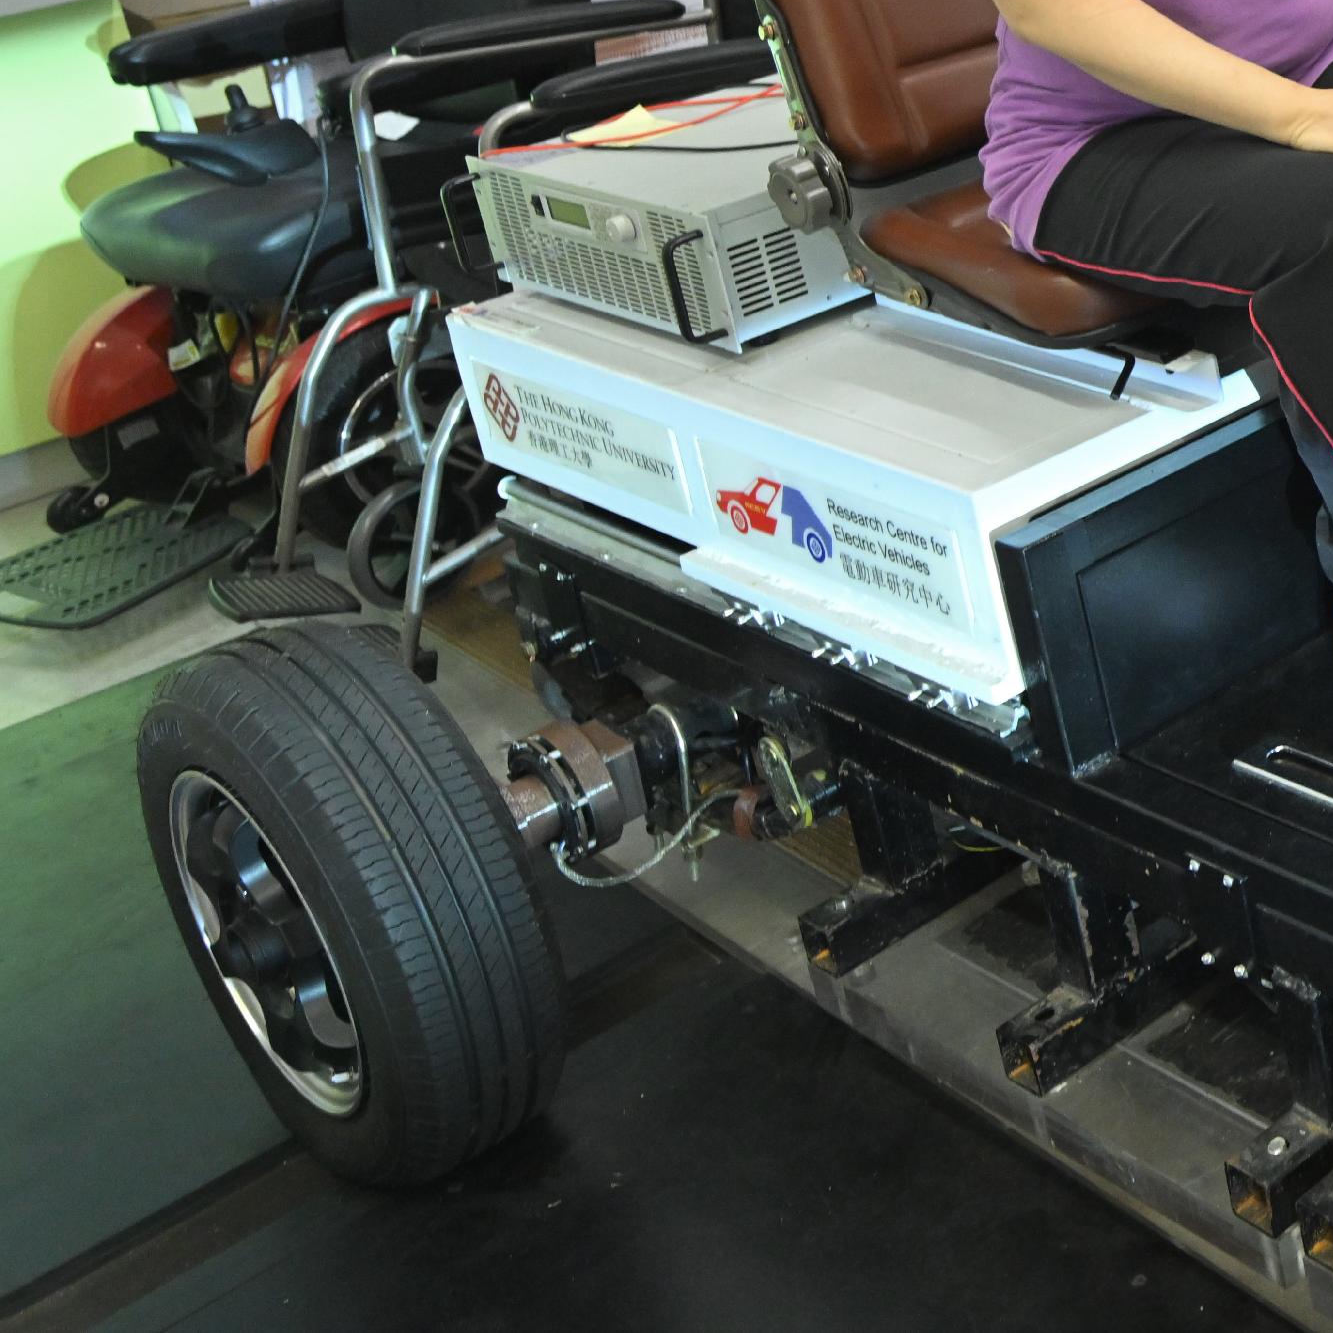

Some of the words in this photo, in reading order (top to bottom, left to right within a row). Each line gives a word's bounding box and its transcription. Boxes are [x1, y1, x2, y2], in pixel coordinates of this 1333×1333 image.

[514, 385, 538, 409] THE
[540, 393, 574, 422] HONG
[575, 407, 615, 438] KONG
[520, 407, 599, 451] POLYTECHNIC
[601, 436, 676, 481] UNIVERSITY
[826, 500, 884, 534] Research
[886, 520, 928, 551] Centre
[930, 536, 947, 558] for
[831, 523, 877, 555] Electric
[877, 541, 931, 576] Vehicles
[839, 554, 951, 616] 電動車研究中心
